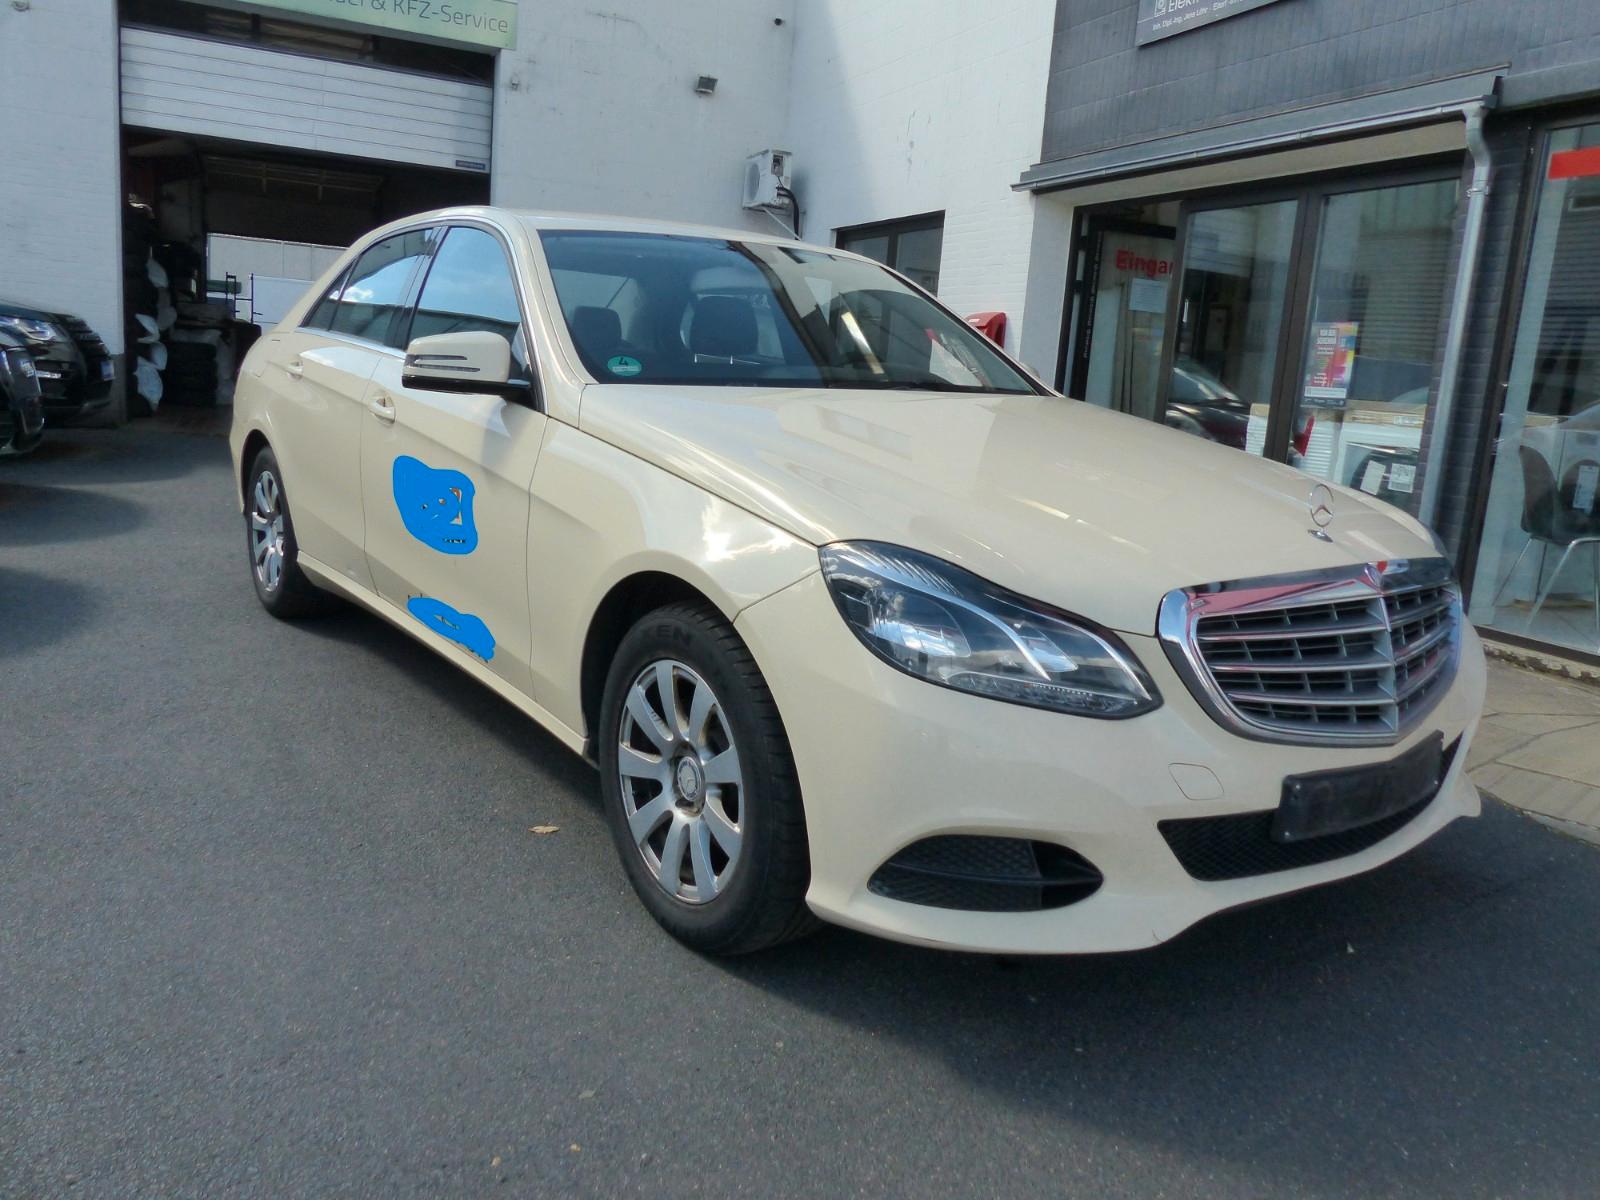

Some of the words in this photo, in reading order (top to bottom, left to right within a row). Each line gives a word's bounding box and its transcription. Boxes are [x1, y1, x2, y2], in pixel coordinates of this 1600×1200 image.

[393, 0, 508, 33] KFZ-Service
[1116, 250, 1174, 277] Einga
[618, 357, 629, 366] 4
